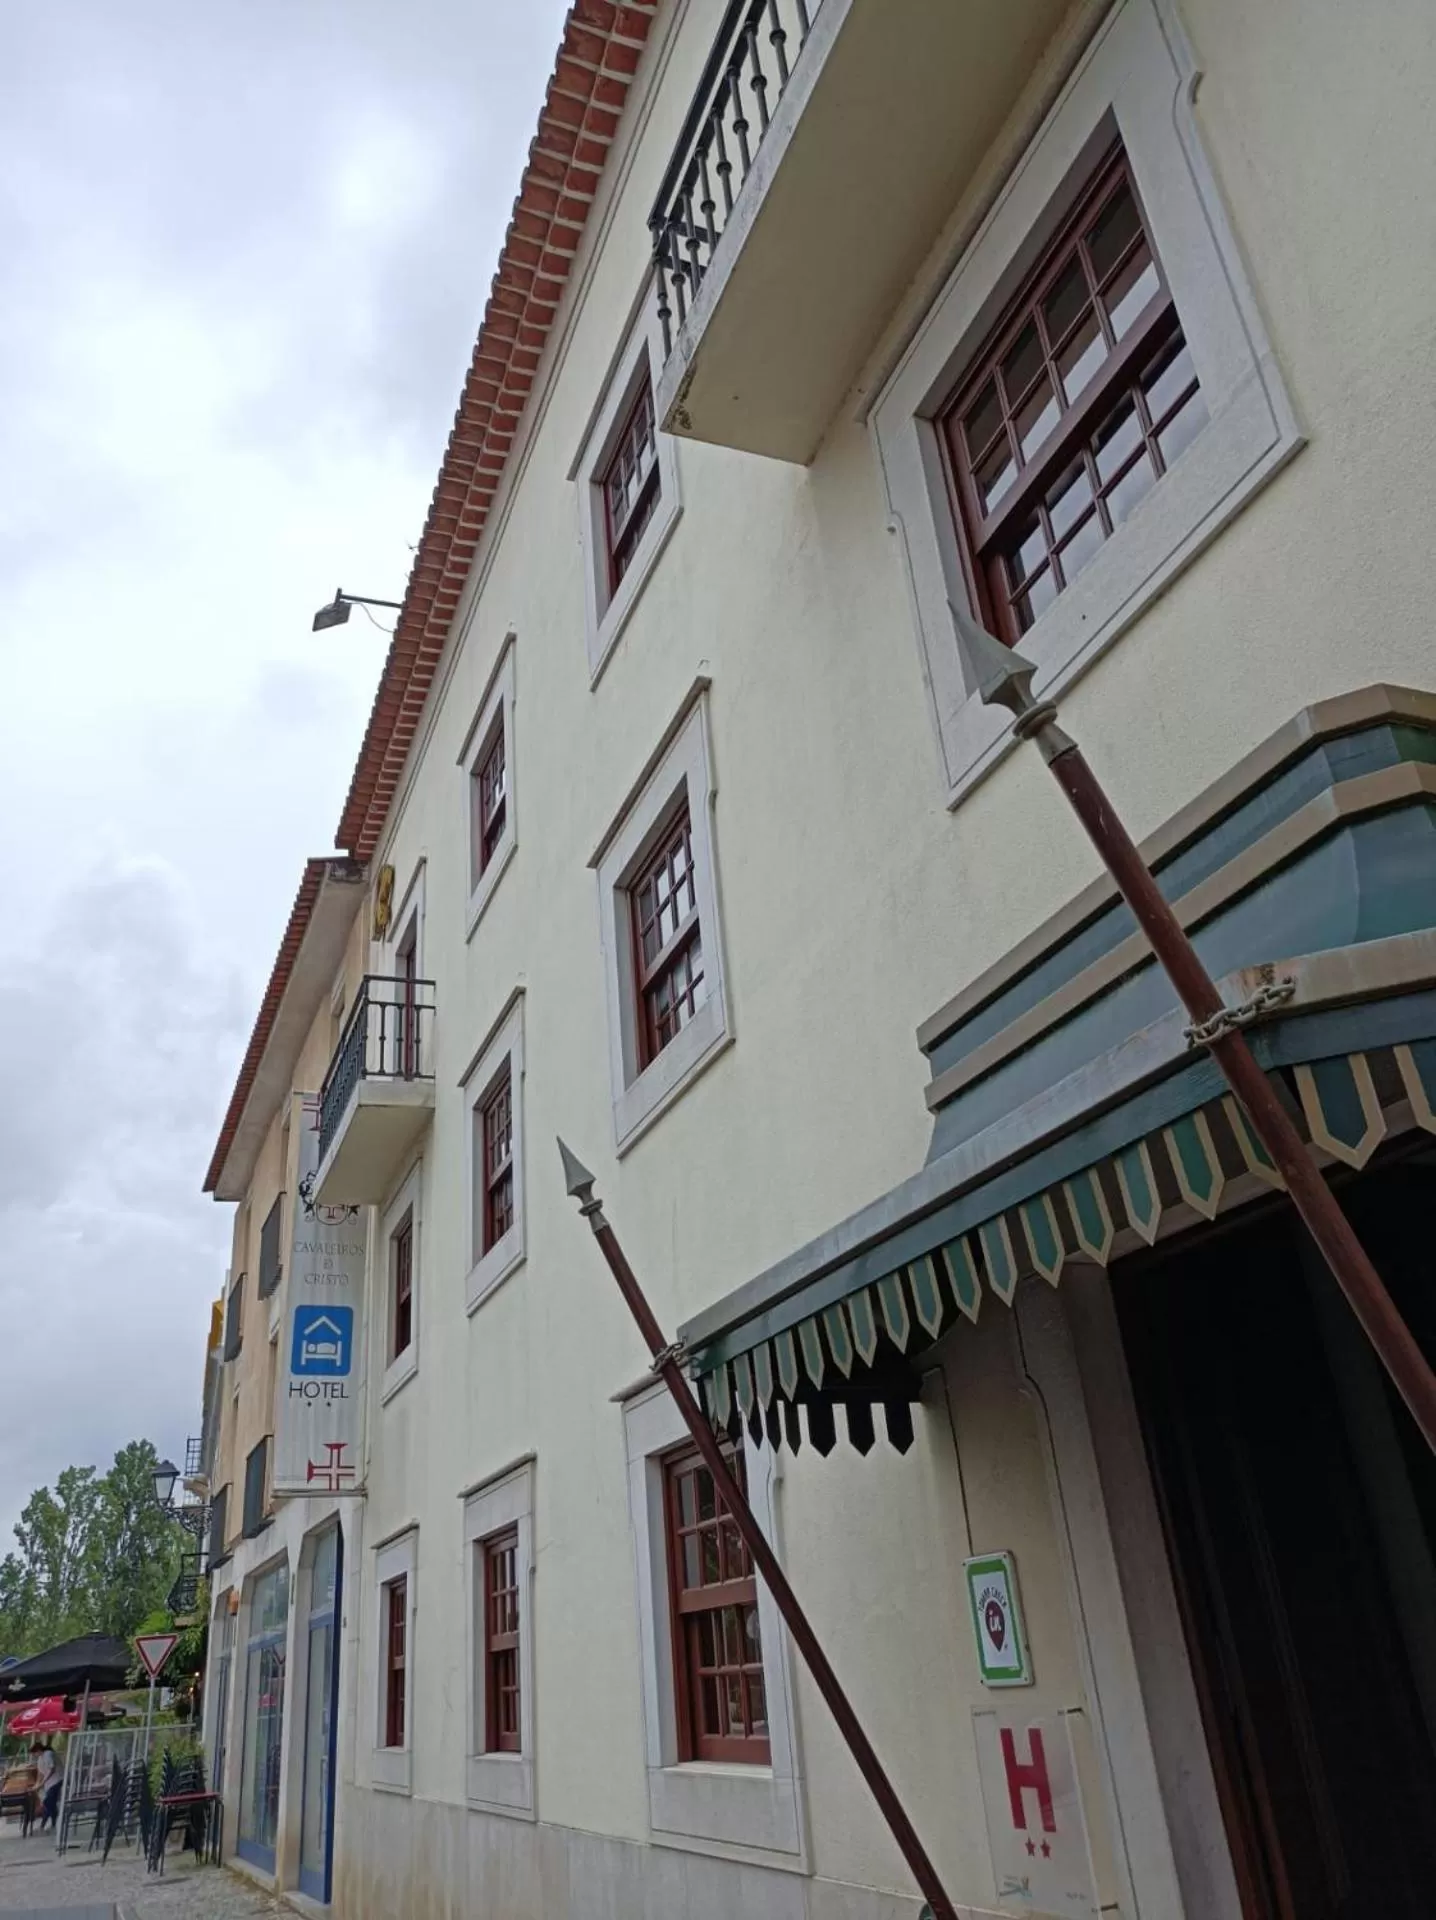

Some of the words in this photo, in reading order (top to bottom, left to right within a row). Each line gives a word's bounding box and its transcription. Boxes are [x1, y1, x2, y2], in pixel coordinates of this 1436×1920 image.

[293, 1240, 365, 1257] CAVALEIROS
[304, 1272, 349, 1286] CRISTO
[289, 1381, 349, 1399] HOTEL
[1000, 1727, 1057, 1833] H
